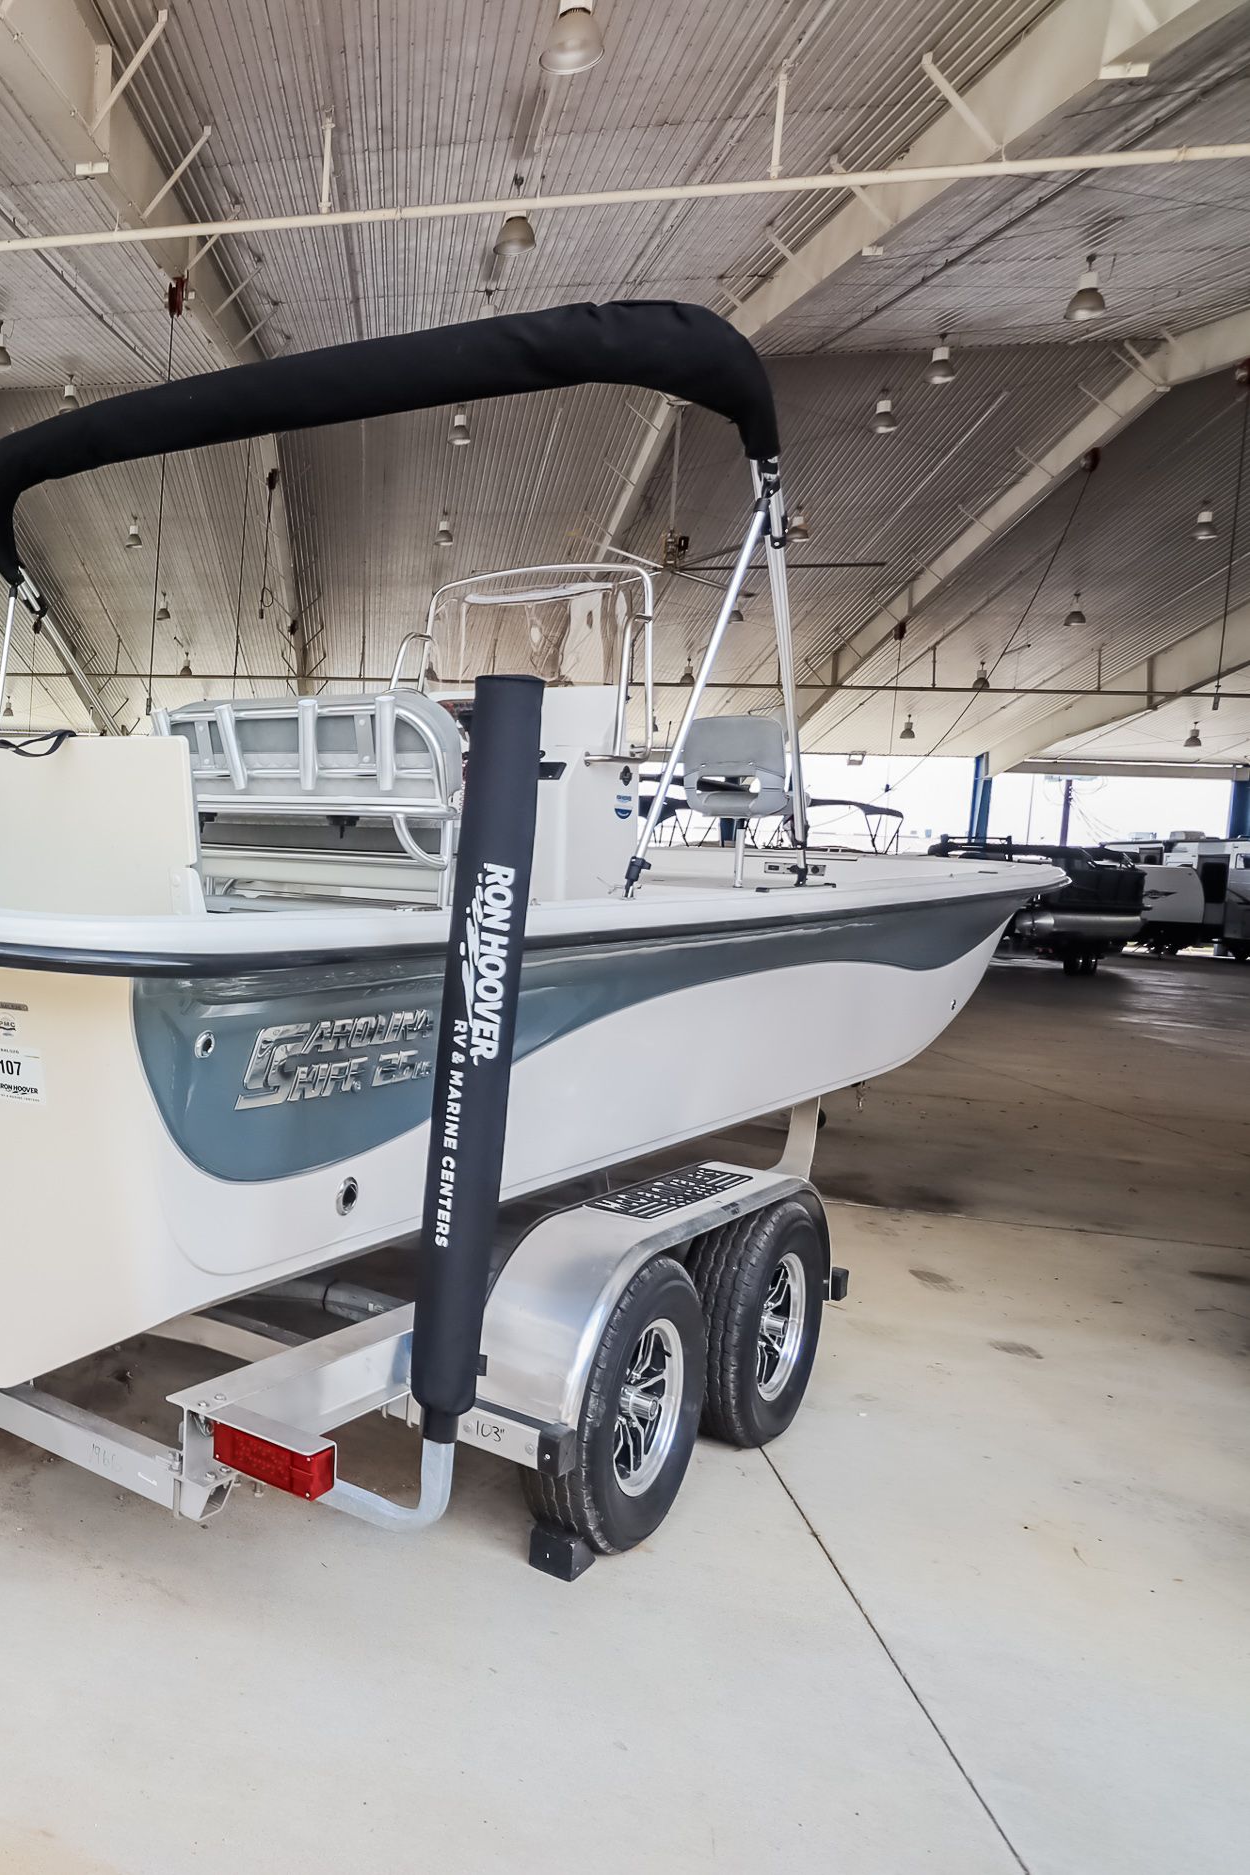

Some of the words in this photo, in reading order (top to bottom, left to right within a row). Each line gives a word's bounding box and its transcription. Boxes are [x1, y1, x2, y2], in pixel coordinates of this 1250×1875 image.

[483, 862, 516, 932] RON
[469, 931, 510, 1062] HOOVER
[451, 1051, 466, 1064] &
[453, 1018, 468, 1049] RV
[0, 1082, 13, 1091] RON
[12, 1085, 39, 1095] HOOVER
[442, 1069, 464, 1151] MARINE
[434, 1155, 457, 1248] CENTERS
